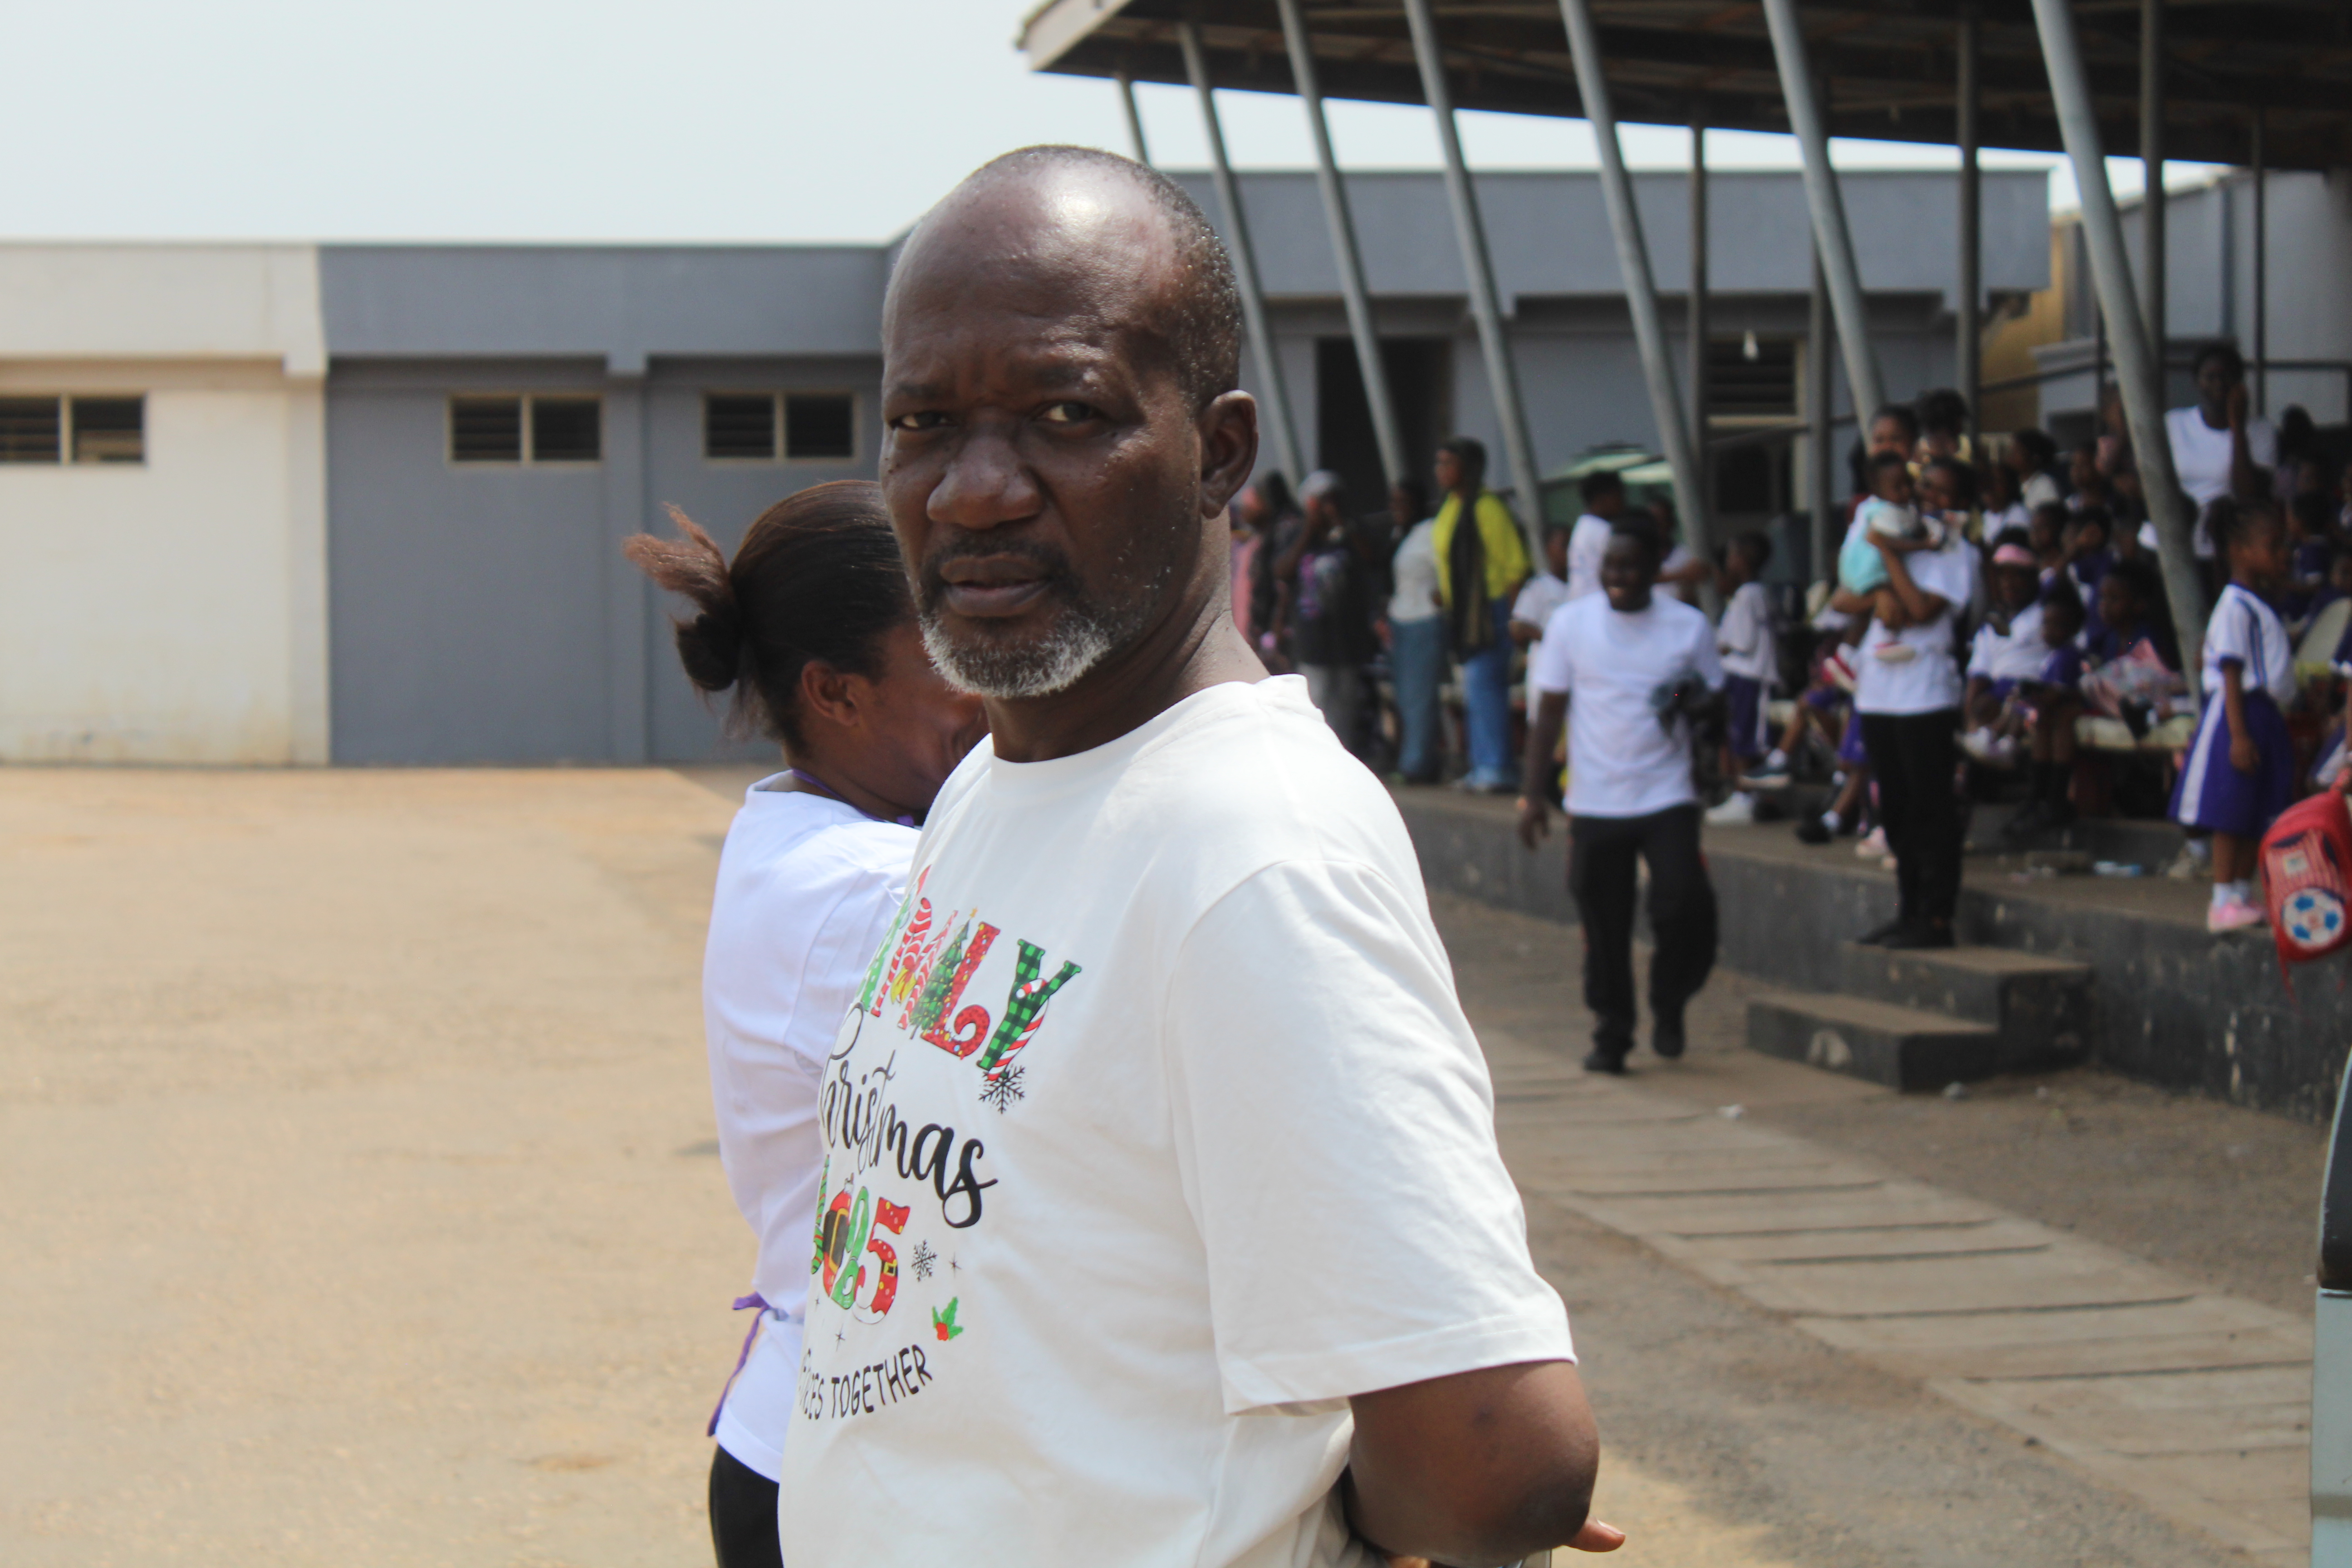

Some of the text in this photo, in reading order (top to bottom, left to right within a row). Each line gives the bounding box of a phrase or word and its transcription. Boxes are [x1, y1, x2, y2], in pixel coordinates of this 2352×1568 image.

[856, 864, 1082, 1081] MILY
[821, 1002, 998, 1229] hristmas
[831, 1344, 933, 1419] TOGETHER
